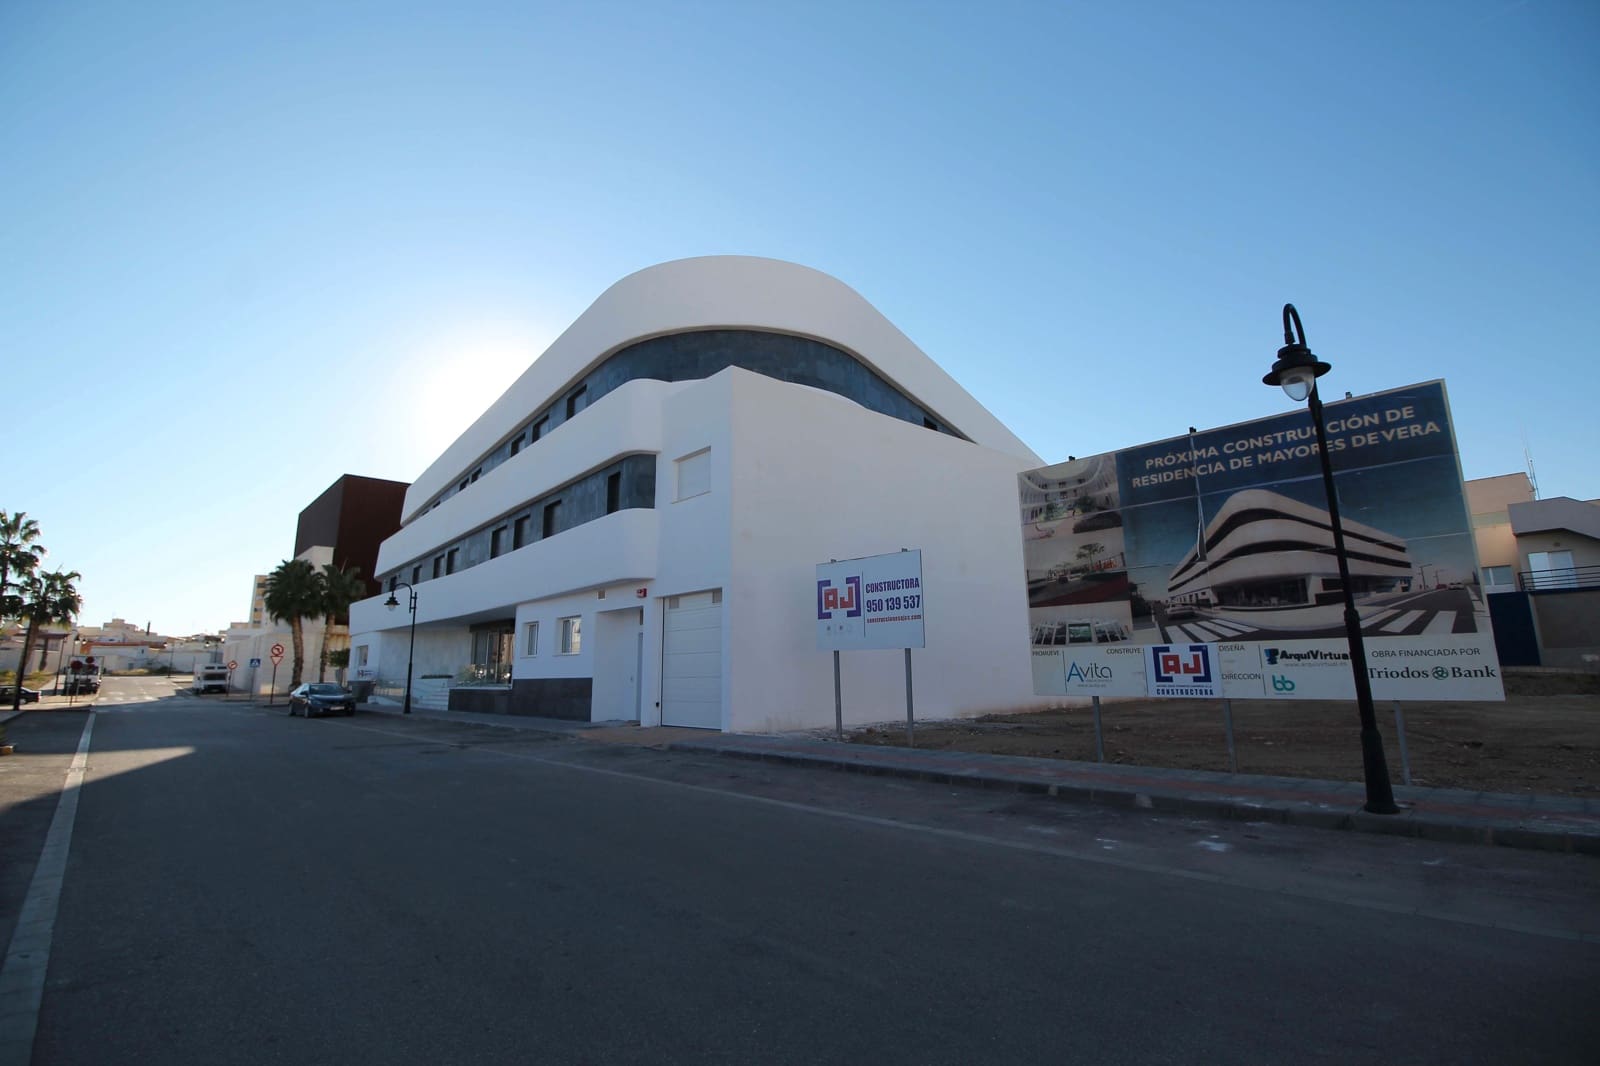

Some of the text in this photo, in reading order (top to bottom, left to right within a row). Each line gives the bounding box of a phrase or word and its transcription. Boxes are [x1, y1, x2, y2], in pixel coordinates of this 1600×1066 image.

[1145, 446, 1219, 471] PRÓXIMA
[1385, 405, 1415, 423] DE
[1131, 421, 1441, 489] RESIDENCIA DE MAYORES DE VERA
[865, 577, 920, 594] CONSTRUCTORA
[866, 594, 921, 613] 950 139 537
[1106, 647, 1141, 655] CONSTRUYE
[1371, 647, 1481, 658] OBRA FINANCIADA POR
[1067, 661, 1113, 682] Avita
[1367, 666, 1497, 679] Triodos Bank
[1156, 688, 1214, 696] CONSTRUCTORA
